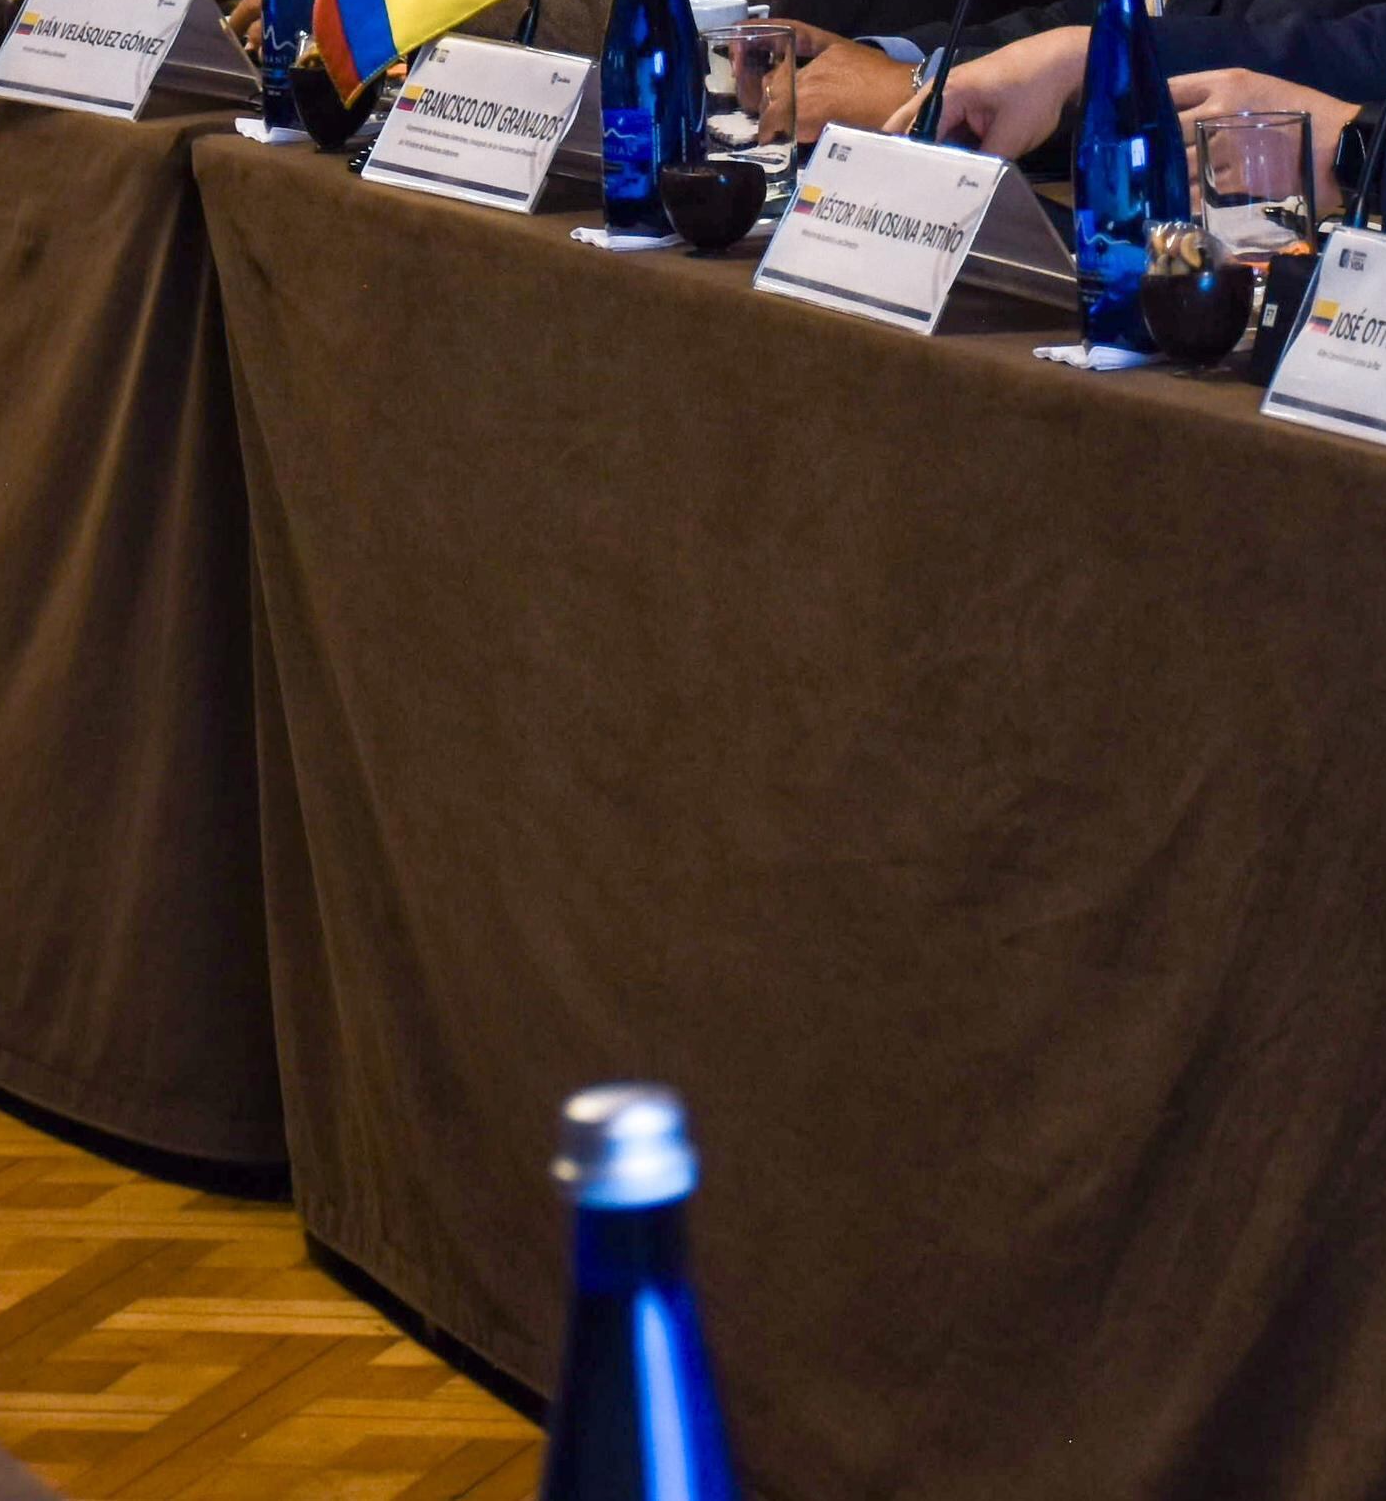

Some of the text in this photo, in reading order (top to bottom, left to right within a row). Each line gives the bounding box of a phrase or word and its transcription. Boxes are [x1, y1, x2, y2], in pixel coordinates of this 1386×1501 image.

[33, 15, 166, 56] IVÁN VELÁSQUEZ GÓMEZ
[414, 88, 478, 125] FRANCISCO
[474, 100, 502, 129] COY
[497, 106, 565, 142] GRANADOS
[812, 192, 857, 226] NÉSTOR
[852, 201, 881, 234] IVÁN
[878, 212, 921, 243] OSUNA
[919, 221, 965, 254] PATIÑO
[1330, 308, 1367, 341] JOSÉ
